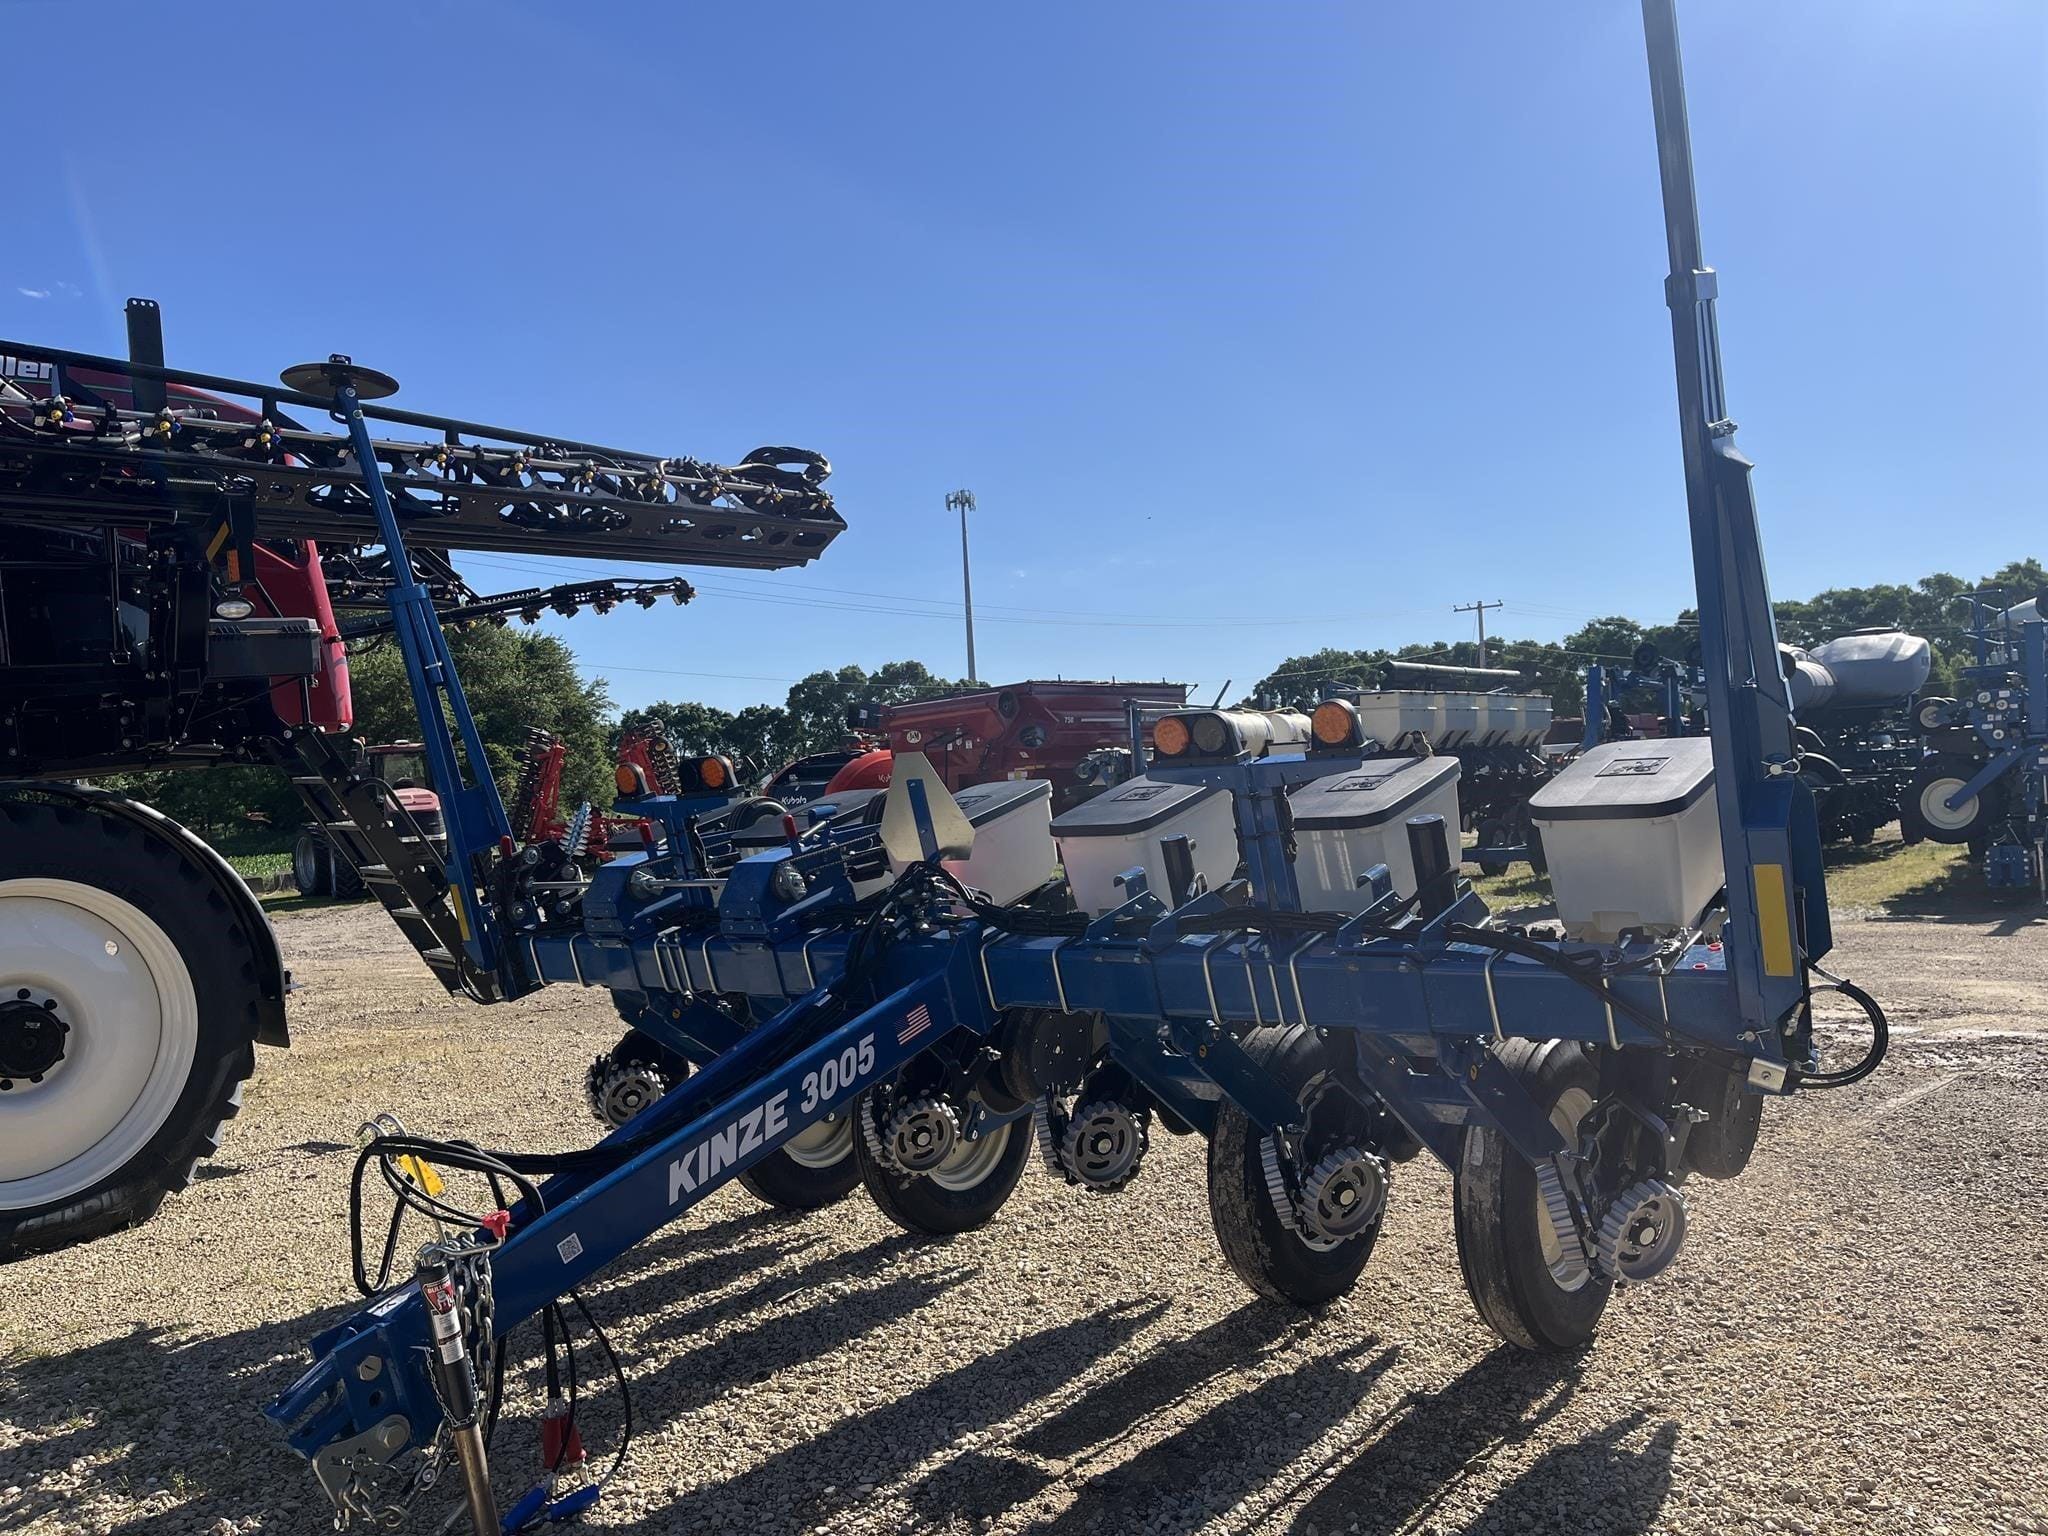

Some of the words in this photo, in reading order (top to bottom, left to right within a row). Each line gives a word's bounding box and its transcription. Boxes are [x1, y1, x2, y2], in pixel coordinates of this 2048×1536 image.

[781, 795, 807, 805] Kubota
[669, 1088, 789, 1206] KINZE
[801, 1032, 875, 1114] 3005
